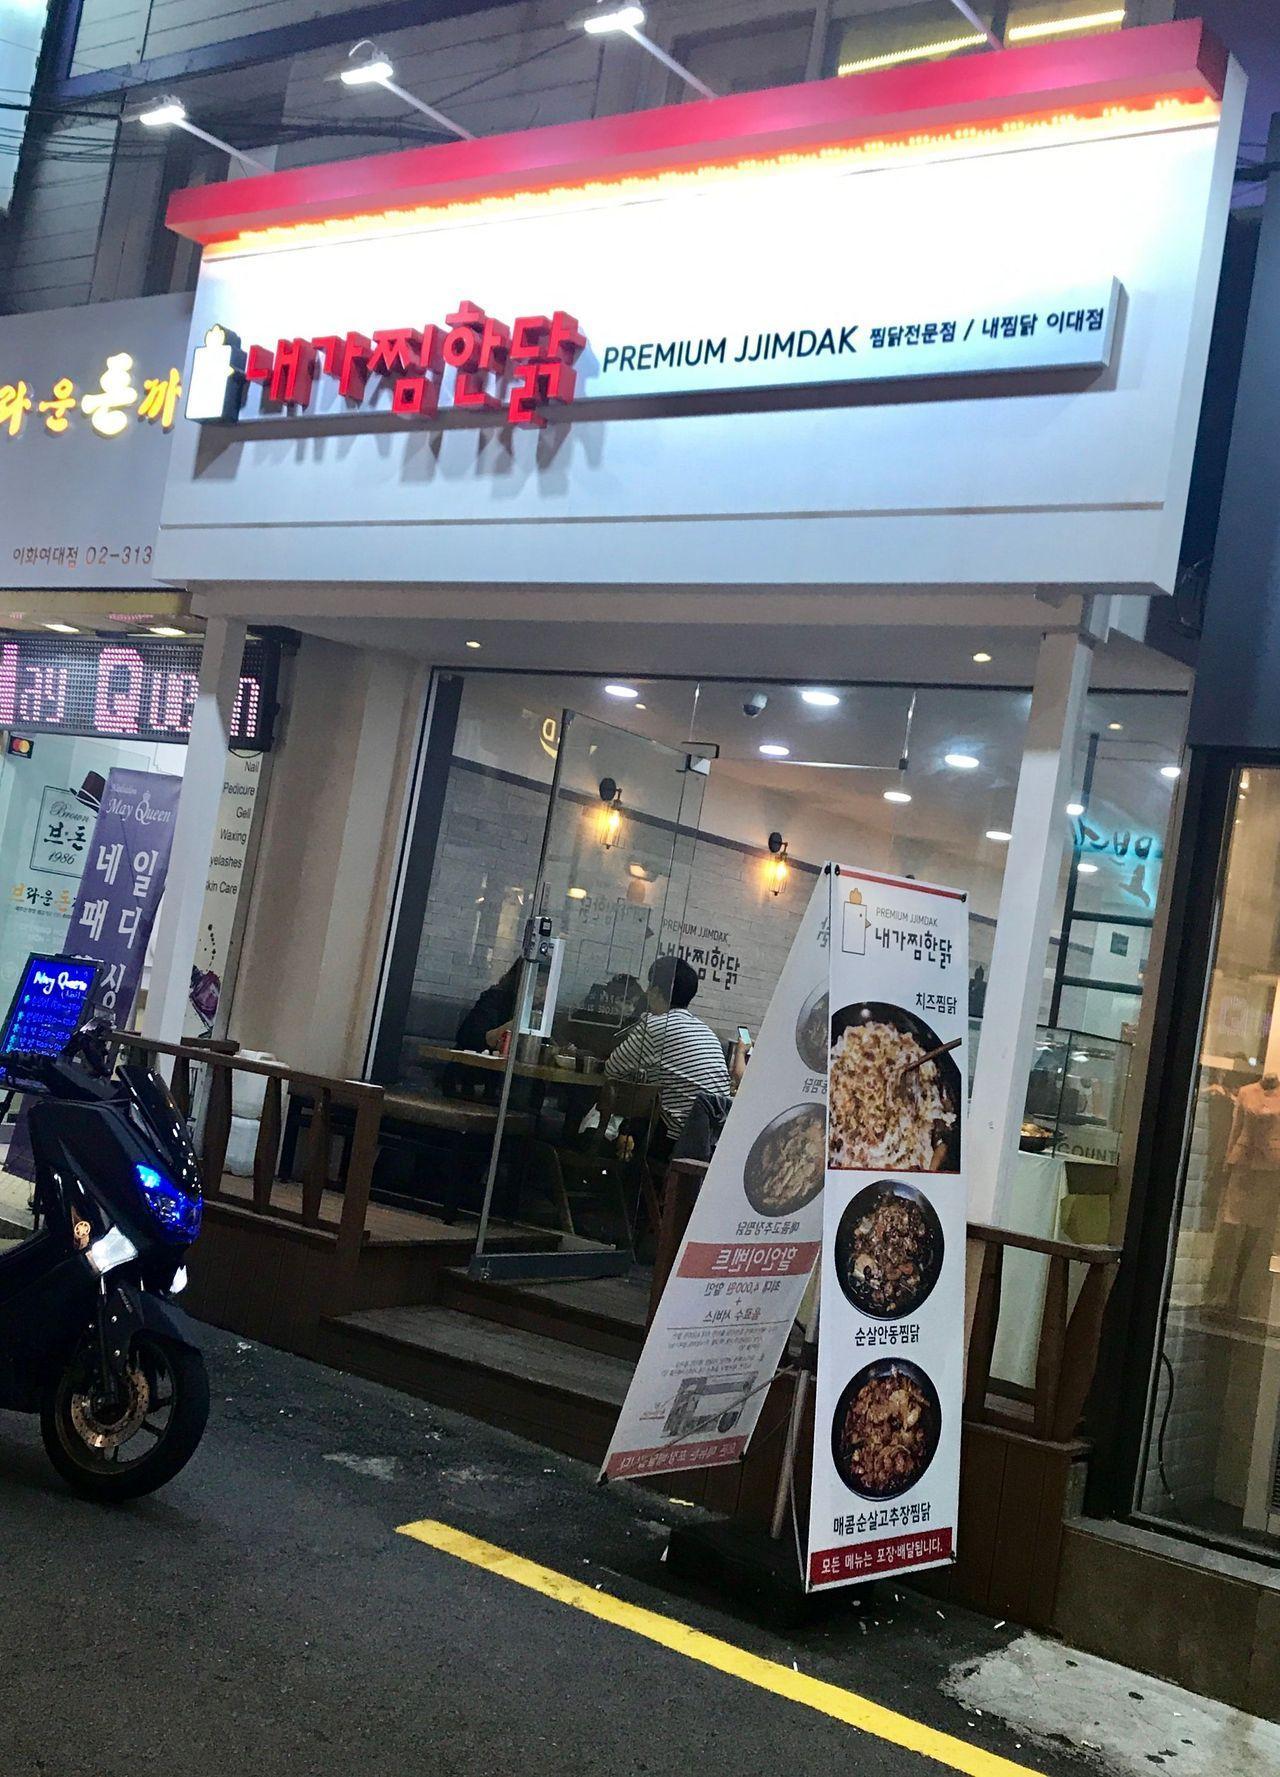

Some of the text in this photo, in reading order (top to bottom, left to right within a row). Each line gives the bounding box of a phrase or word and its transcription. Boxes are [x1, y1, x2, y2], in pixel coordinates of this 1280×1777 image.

[870, 320, 956, 349] 찜닭전문점
[982, 313, 1038, 339] 내찜닭
[1046, 307, 1104, 334] 이대점
[602, 325, 858, 372] PREMIUM JJIMDAK
[245, 300, 586, 428] 내가찜한닭
[13, 545, 153, 569] 이화여대점 02-313
[94, 647, 260, 738] Quen
[244, 761, 260, 773] Nail
[223, 782, 255, 796] Pedicure
[50, 800, 90, 824] Brown
[106, 798, 171, 825] May Queen
[220, 828, 247, 845] Waxing
[48, 851, 75, 866] 1986
[209, 855, 243, 868] yelashes
[219, 881, 238, 894] Care
[876, 906, 938, 927] PREMIUM JJIMDAK
[663, 918, 730, 942] PREMIUM JJIMDAK
[875, 927, 953, 969] 내가찜한닭
[916, 992, 957, 1015] 치즈찜닭
[854, 1324, 920, 1346] 순살안동찜닭
[833, 1501, 931, 1536] 매콤순살고추장찜닭
[821, 1556, 840, 1574] 모든
[845, 1551, 873, 1571] 메뉴는
